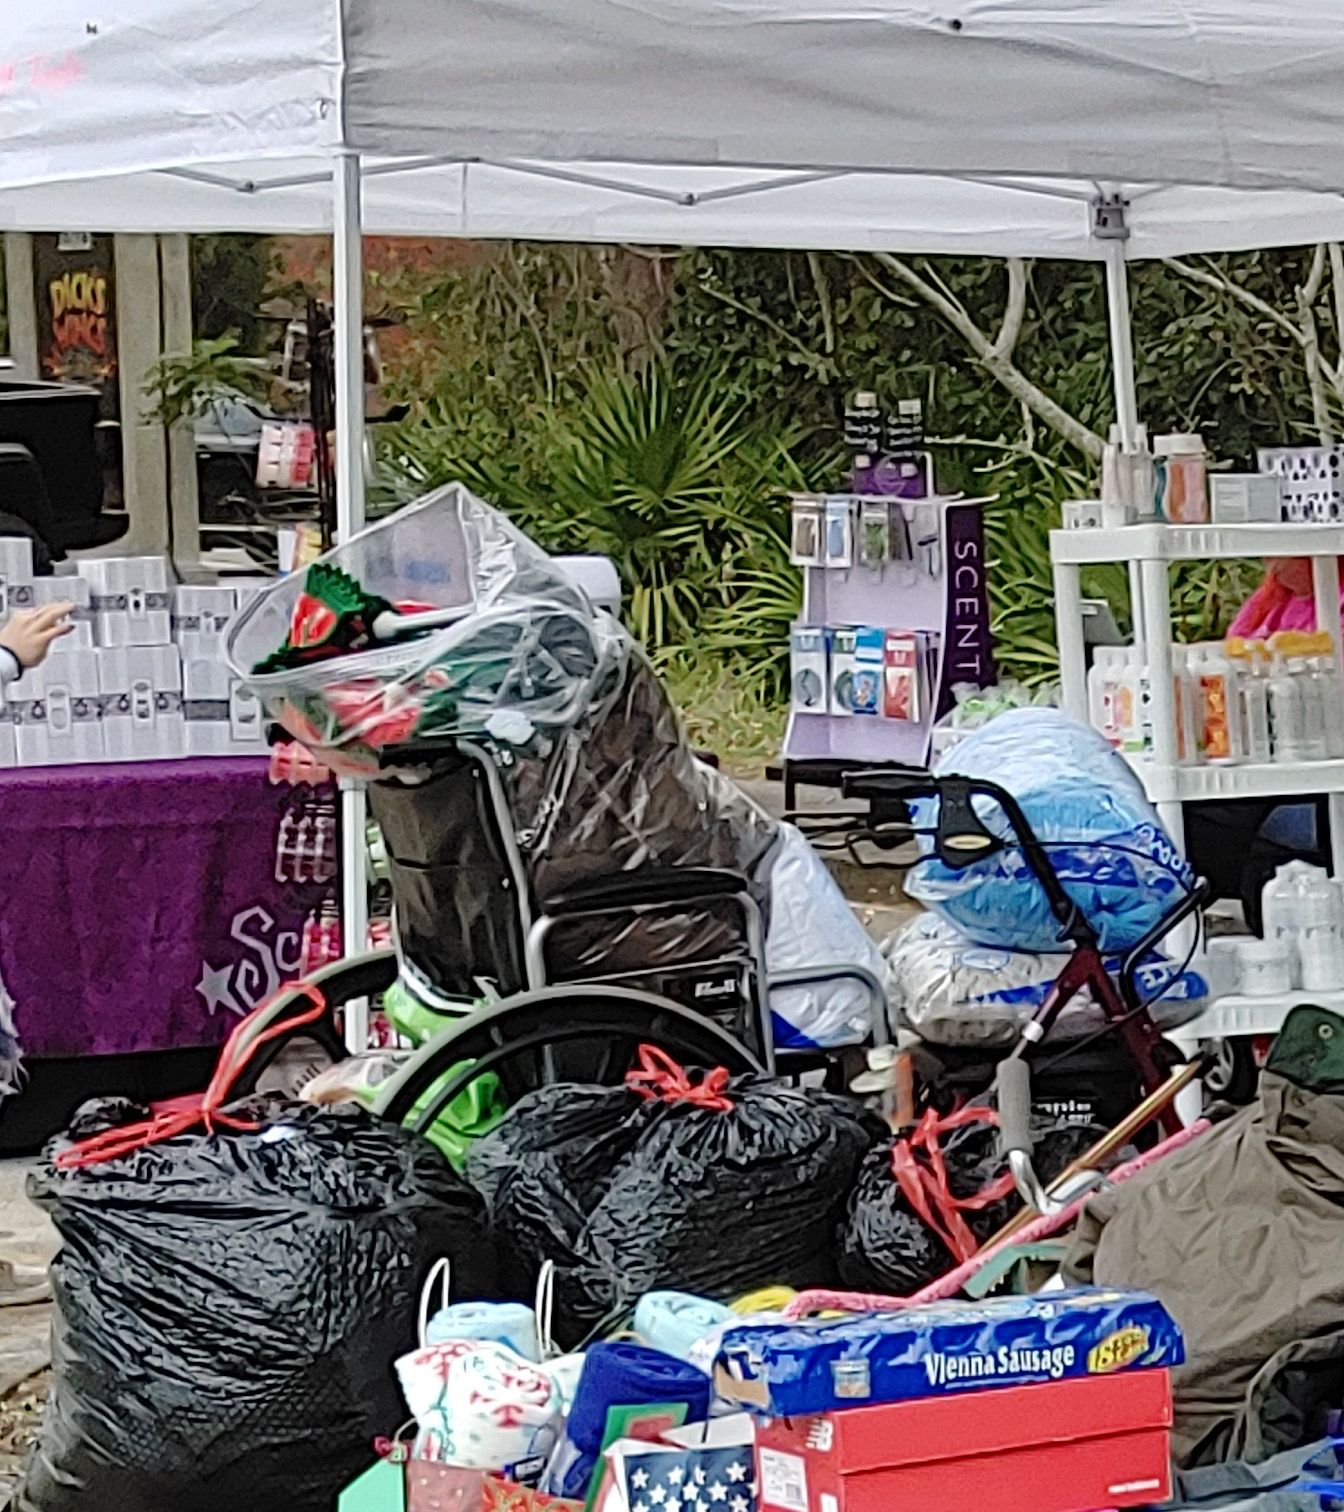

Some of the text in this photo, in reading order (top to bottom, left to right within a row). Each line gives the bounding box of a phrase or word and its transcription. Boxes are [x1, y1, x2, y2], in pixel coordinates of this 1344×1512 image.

[954, 540, 981, 675] SCENT
[924, 1352, 995, 1386] Vienna
[997, 1343, 1076, 1378] Sausage
